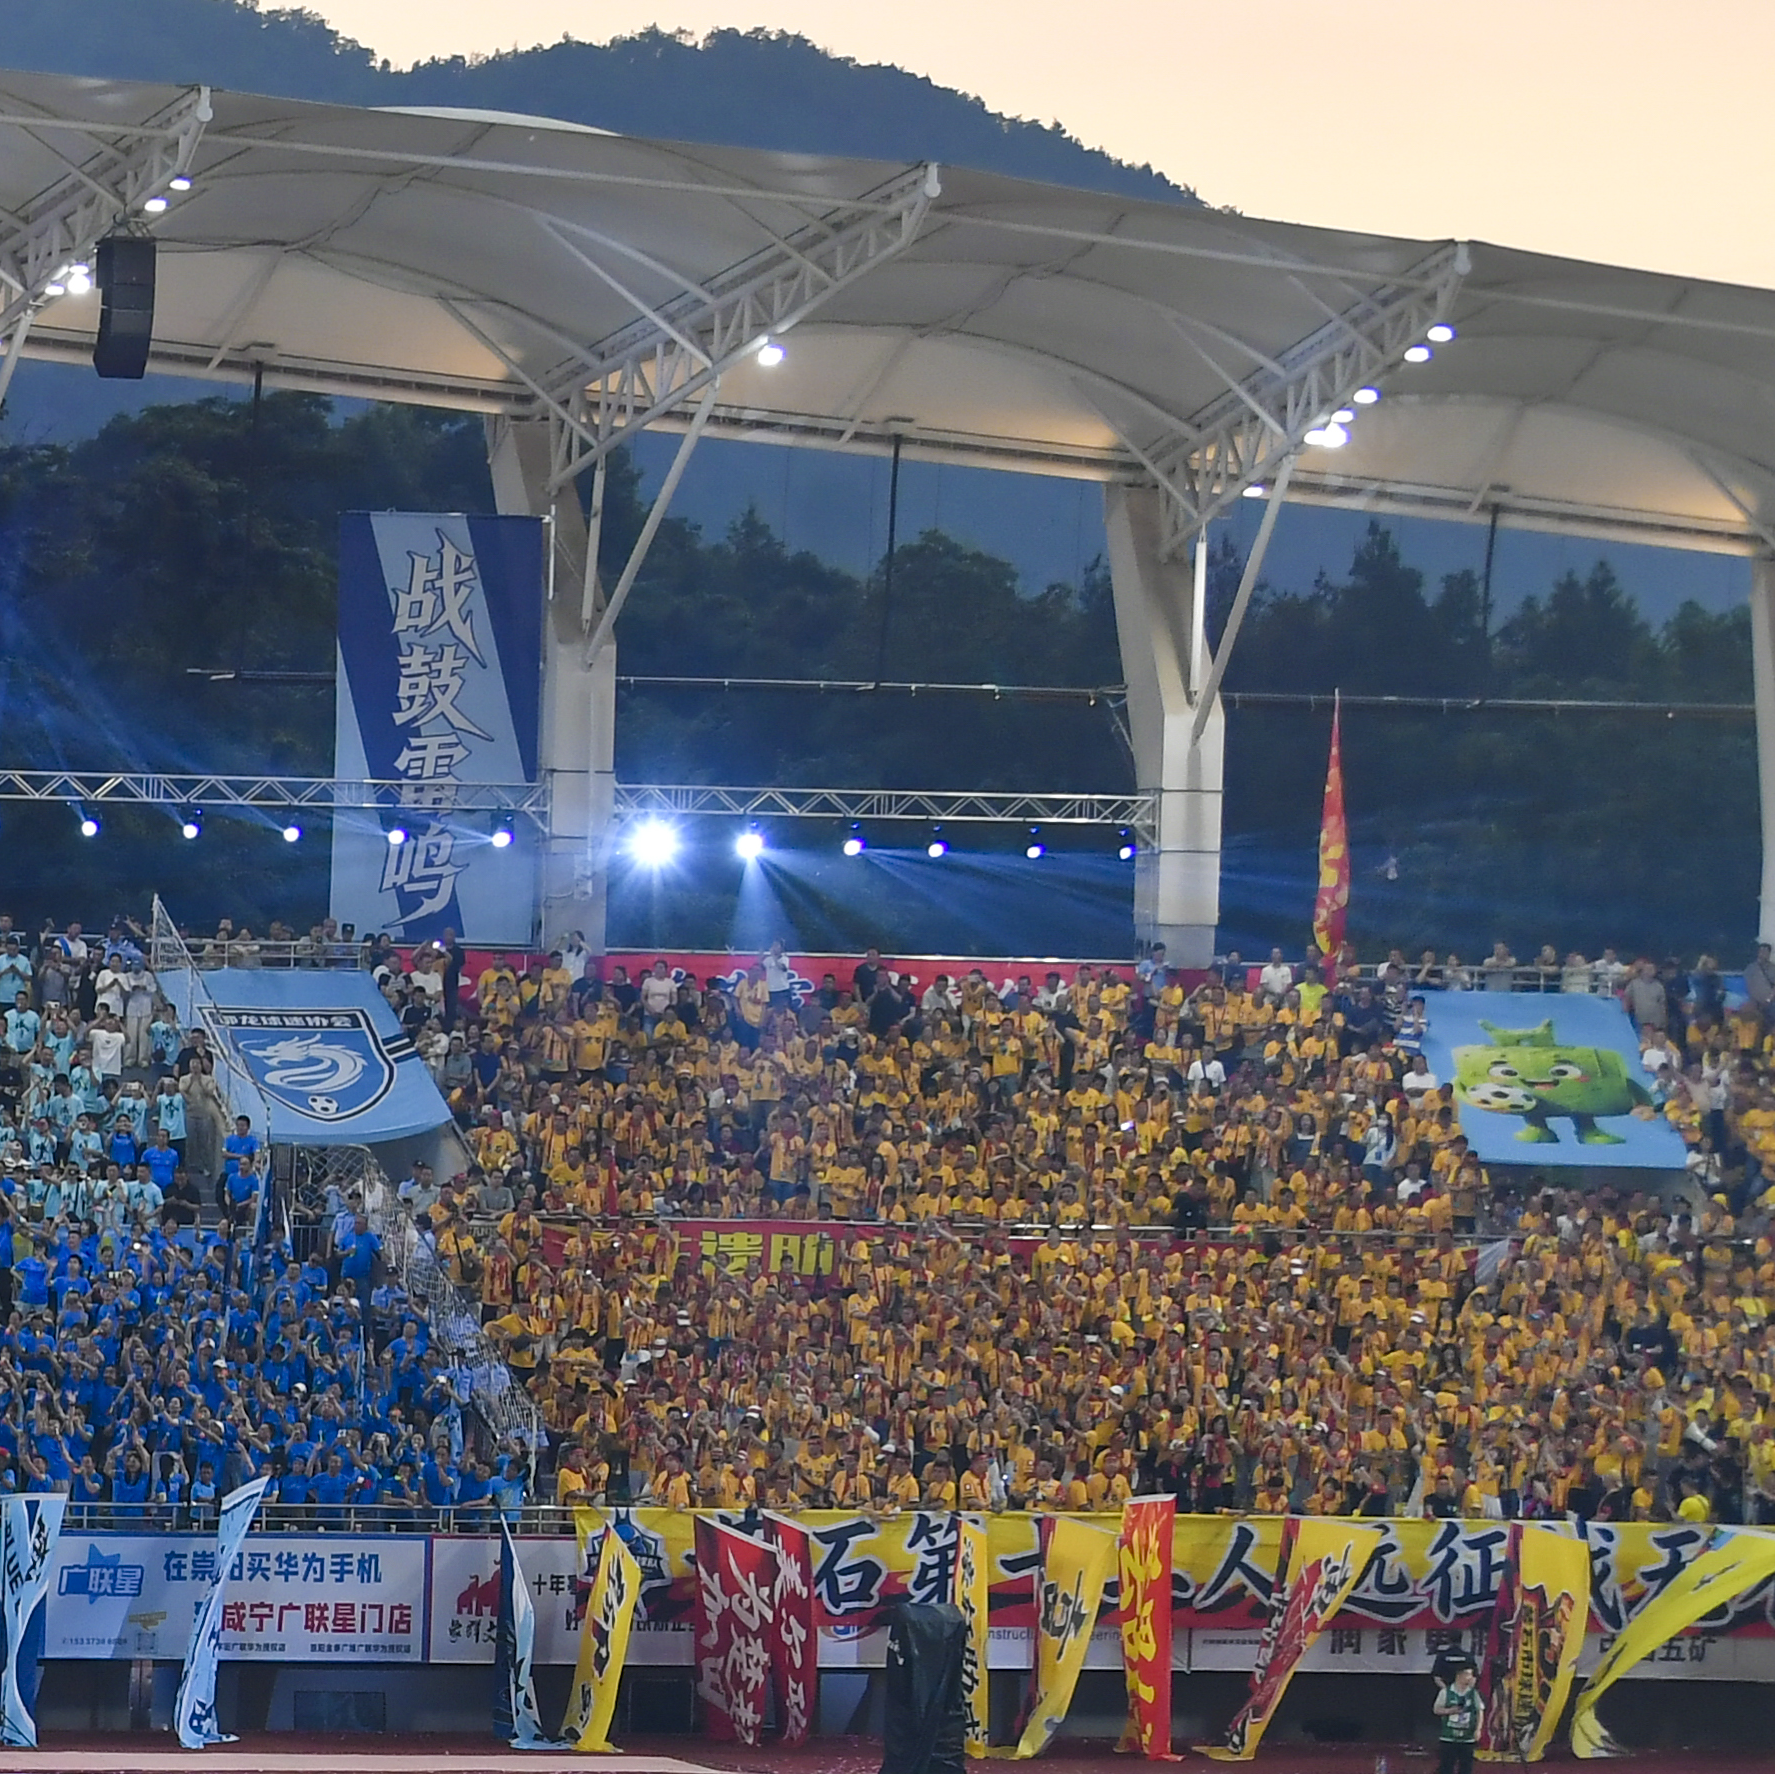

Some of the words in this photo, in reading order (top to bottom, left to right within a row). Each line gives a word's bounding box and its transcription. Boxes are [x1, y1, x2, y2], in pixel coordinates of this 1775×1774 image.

[382, 527, 494, 928] 战鼓雷鸣
[59, 1565, 144, 1597] 广联星
